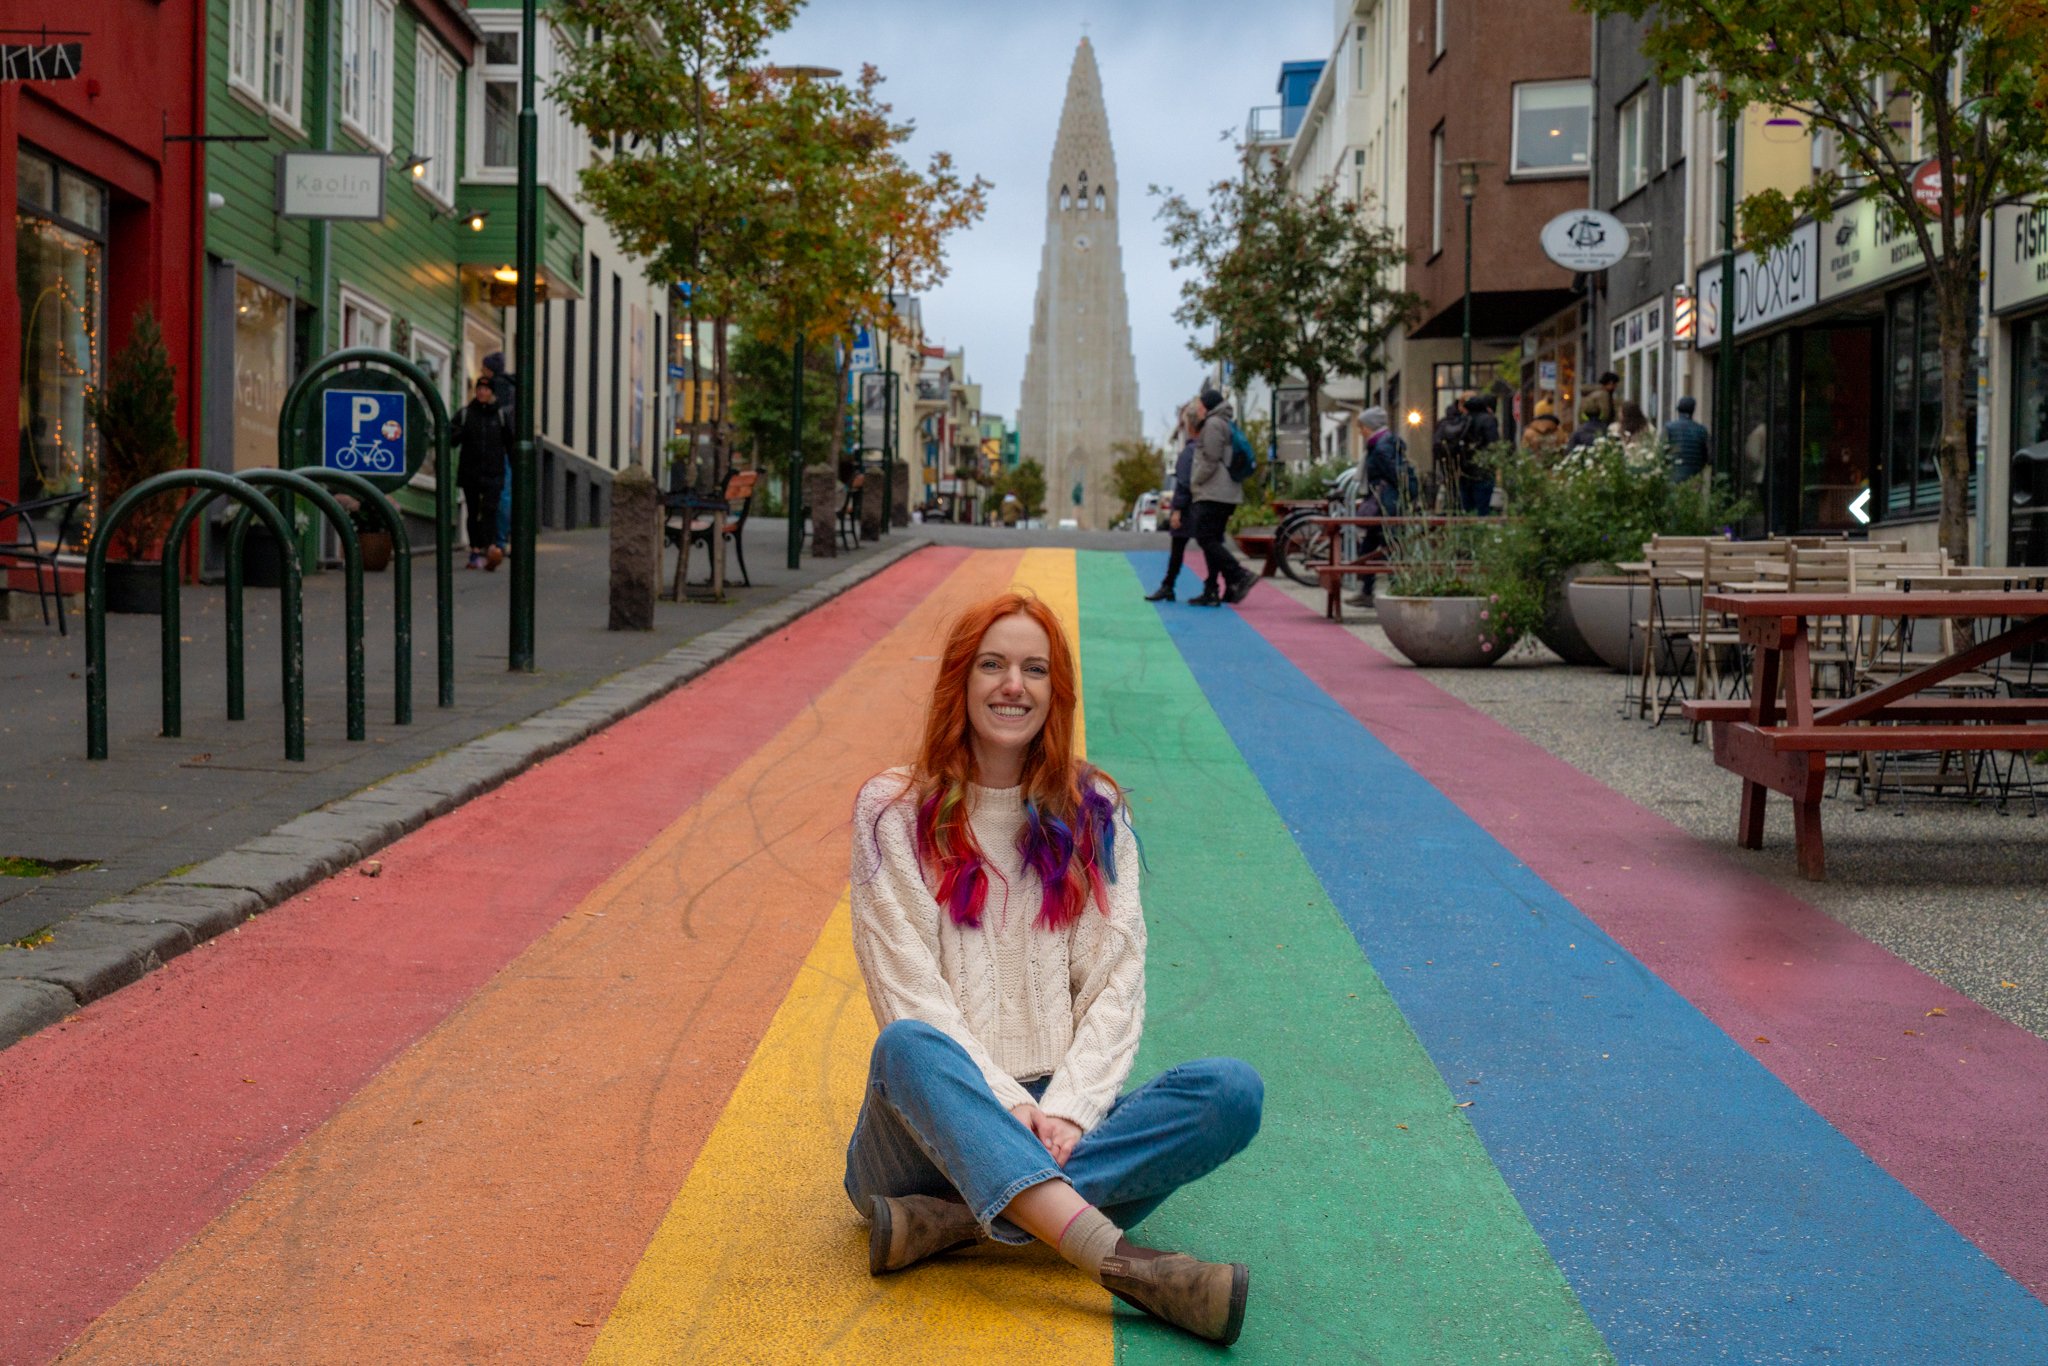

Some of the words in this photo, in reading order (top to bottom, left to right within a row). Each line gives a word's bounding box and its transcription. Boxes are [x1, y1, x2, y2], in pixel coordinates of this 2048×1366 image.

[296, 174, 371, 192] Kaolin
[2015, 206, 2048, 263] FISH
[352, 396, 380, 433] P
